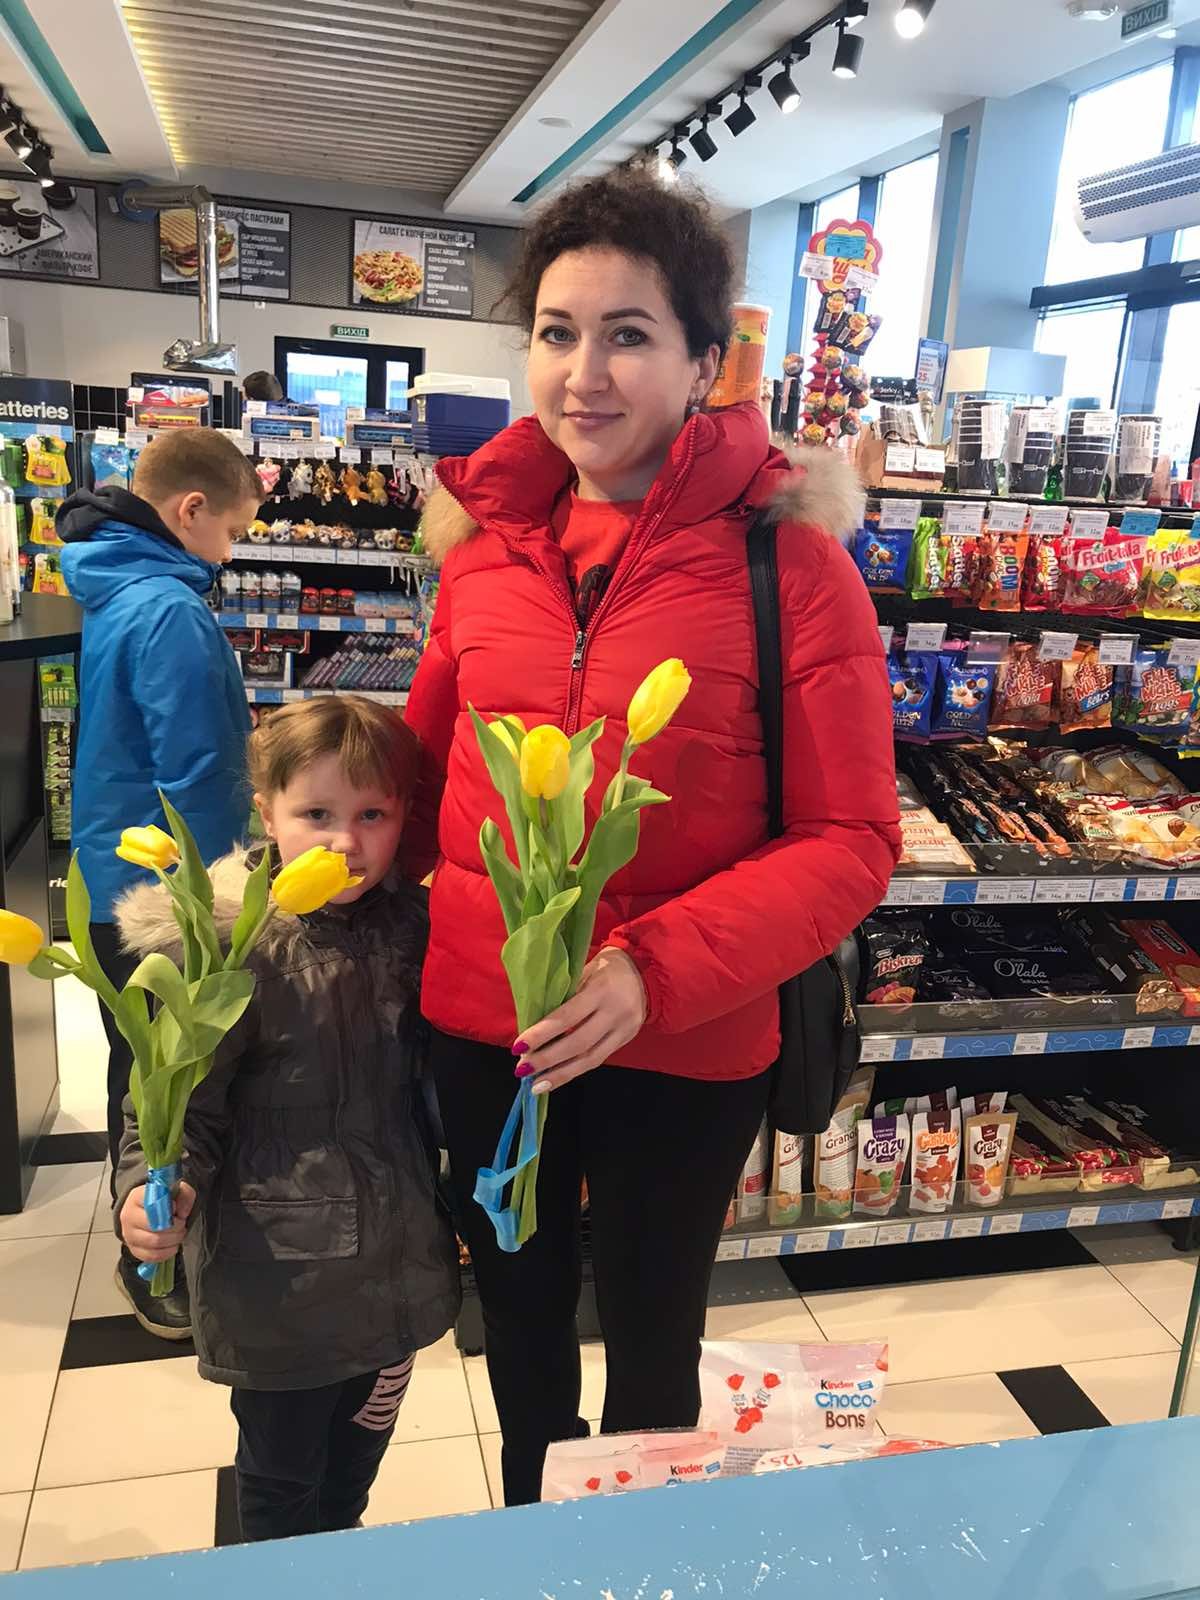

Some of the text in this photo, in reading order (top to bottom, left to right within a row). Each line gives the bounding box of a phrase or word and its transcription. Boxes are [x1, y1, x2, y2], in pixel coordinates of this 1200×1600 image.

[1125, 3, 1165, 33] ВИХІД
[337, 326, 367, 337] ВИХІД
[994, 957, 1048, 978] O'lala
[864, 1138, 905, 1160] Crazy
[825, 1410, 866, 1428] Bons
